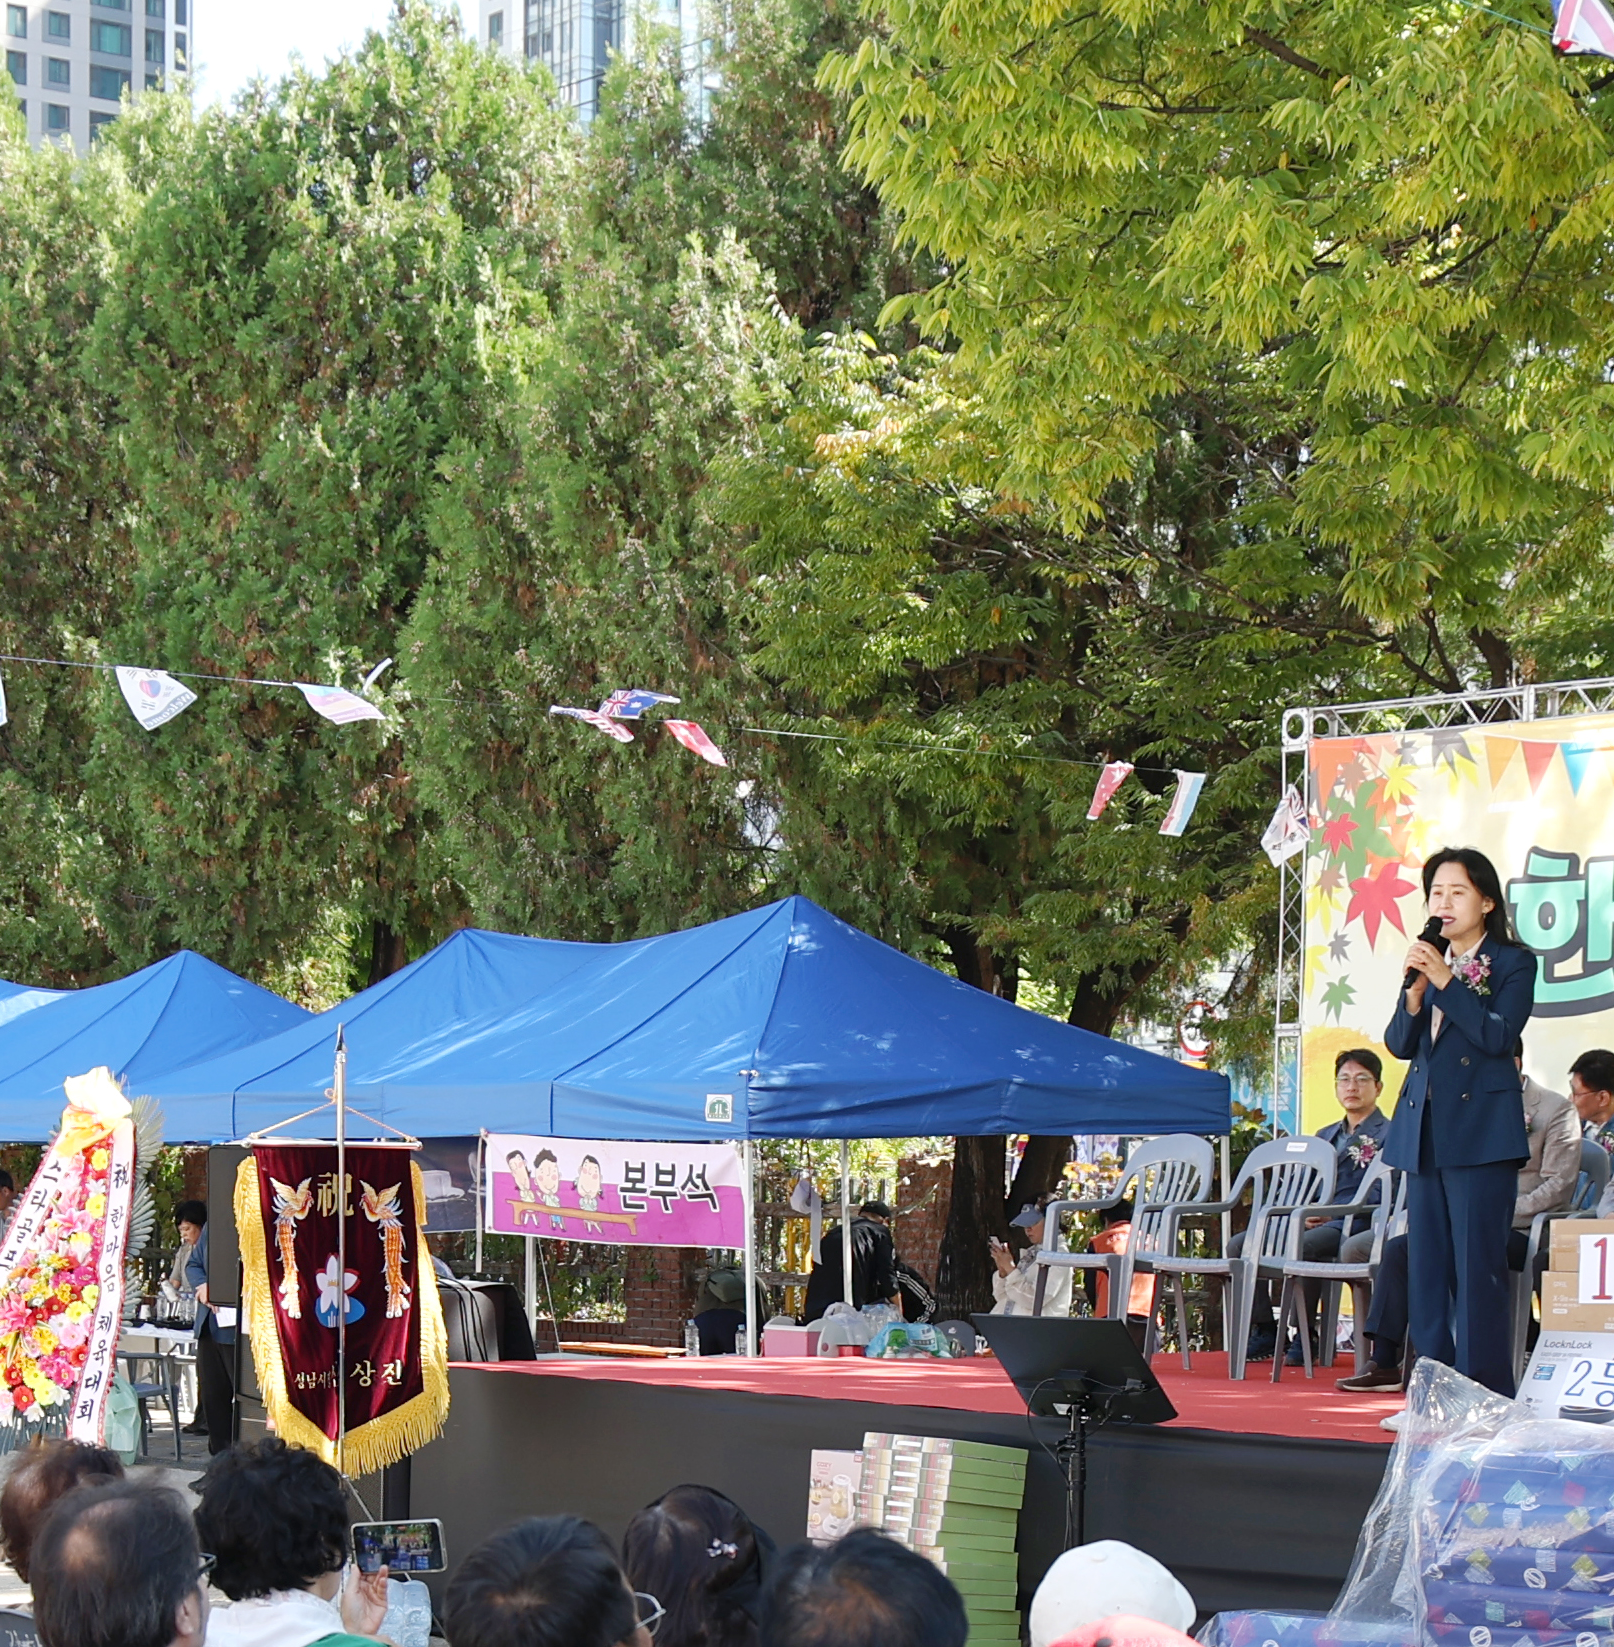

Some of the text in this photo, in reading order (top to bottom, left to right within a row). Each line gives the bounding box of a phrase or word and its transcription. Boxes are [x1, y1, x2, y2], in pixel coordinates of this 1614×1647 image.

[317, 1171, 355, 1219] 祝
[619, 1159, 719, 1213] 본부석
[103, 1206, 124, 1293] 한마음
[76, 1311, 113, 1425] 체육대회
[1544, 1339, 1593, 1350] LocknLock
